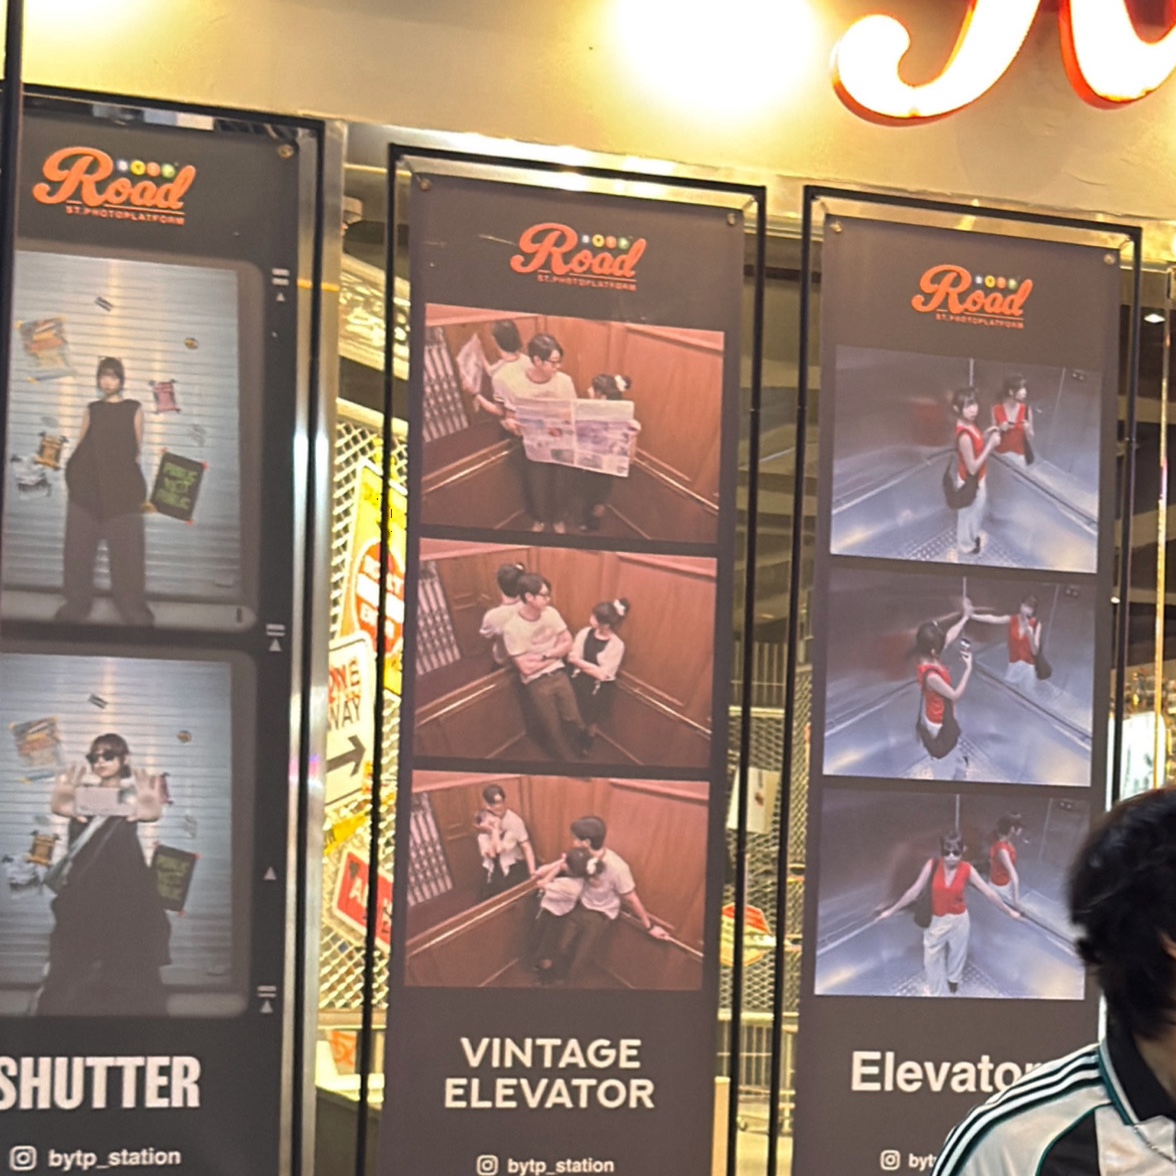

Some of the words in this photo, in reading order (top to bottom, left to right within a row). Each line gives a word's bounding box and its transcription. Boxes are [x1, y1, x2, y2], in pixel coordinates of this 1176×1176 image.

[32, 146, 196, 207] Road
[510, 222, 647, 275] Road
[911, 264, 1033, 316] Road
[460, 1037, 642, 1068] VINTAGE
[445, 1078, 655, 1108] ELEVATOR
[48, 1147, 182, 1171] bytp_station
[507, 1157, 615, 1176] bytp_station
